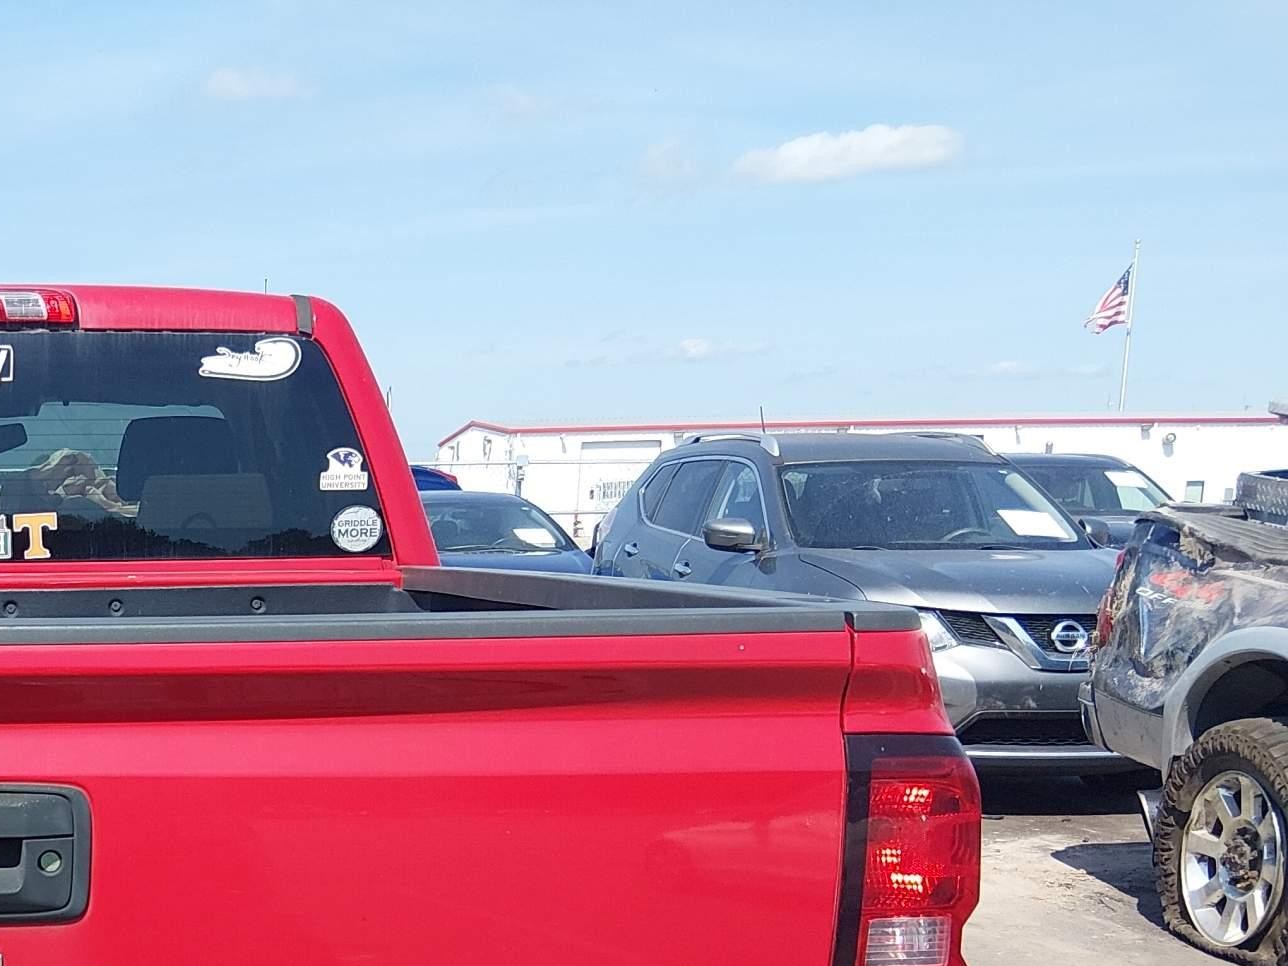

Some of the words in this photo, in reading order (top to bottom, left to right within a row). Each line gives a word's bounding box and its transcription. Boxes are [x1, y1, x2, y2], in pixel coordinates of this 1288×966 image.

[322, 481, 366, 489] UNIVERSITY
[337, 519, 378, 527] GRIDDLE
[337, 527, 378, 539] MORE
